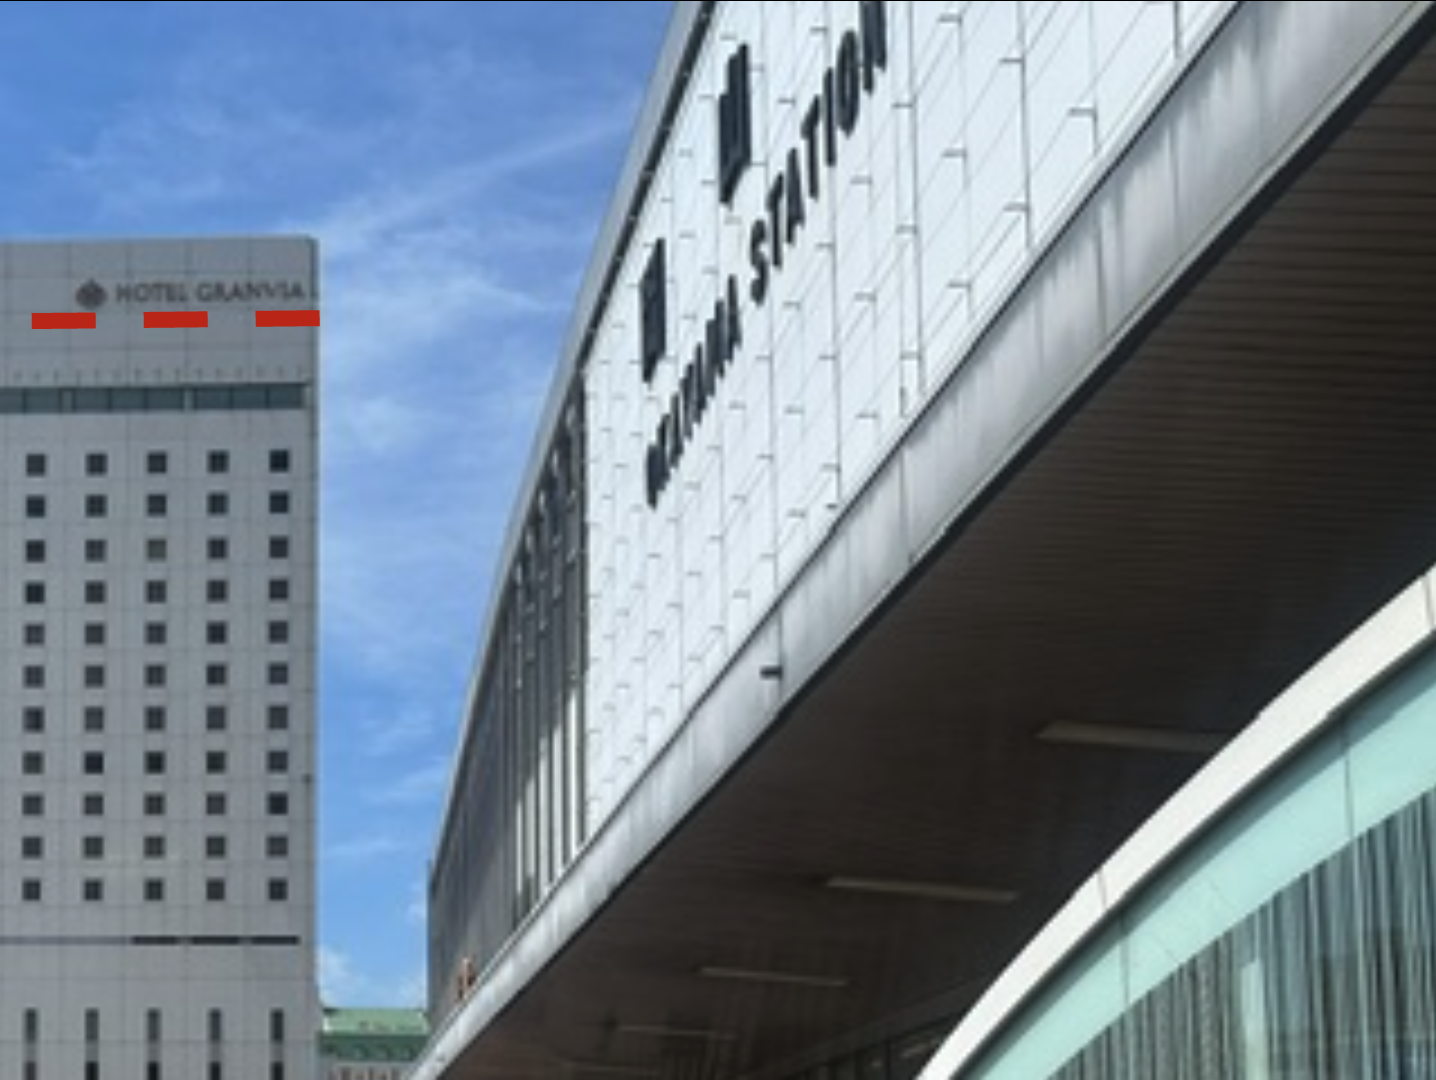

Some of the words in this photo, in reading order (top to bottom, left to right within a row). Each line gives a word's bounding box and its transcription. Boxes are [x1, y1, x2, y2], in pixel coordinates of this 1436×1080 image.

[749, 0, 887, 305] STATION
[115, 282, 186, 303] HOTEL
[197, 278, 305, 301] GRANVIA
